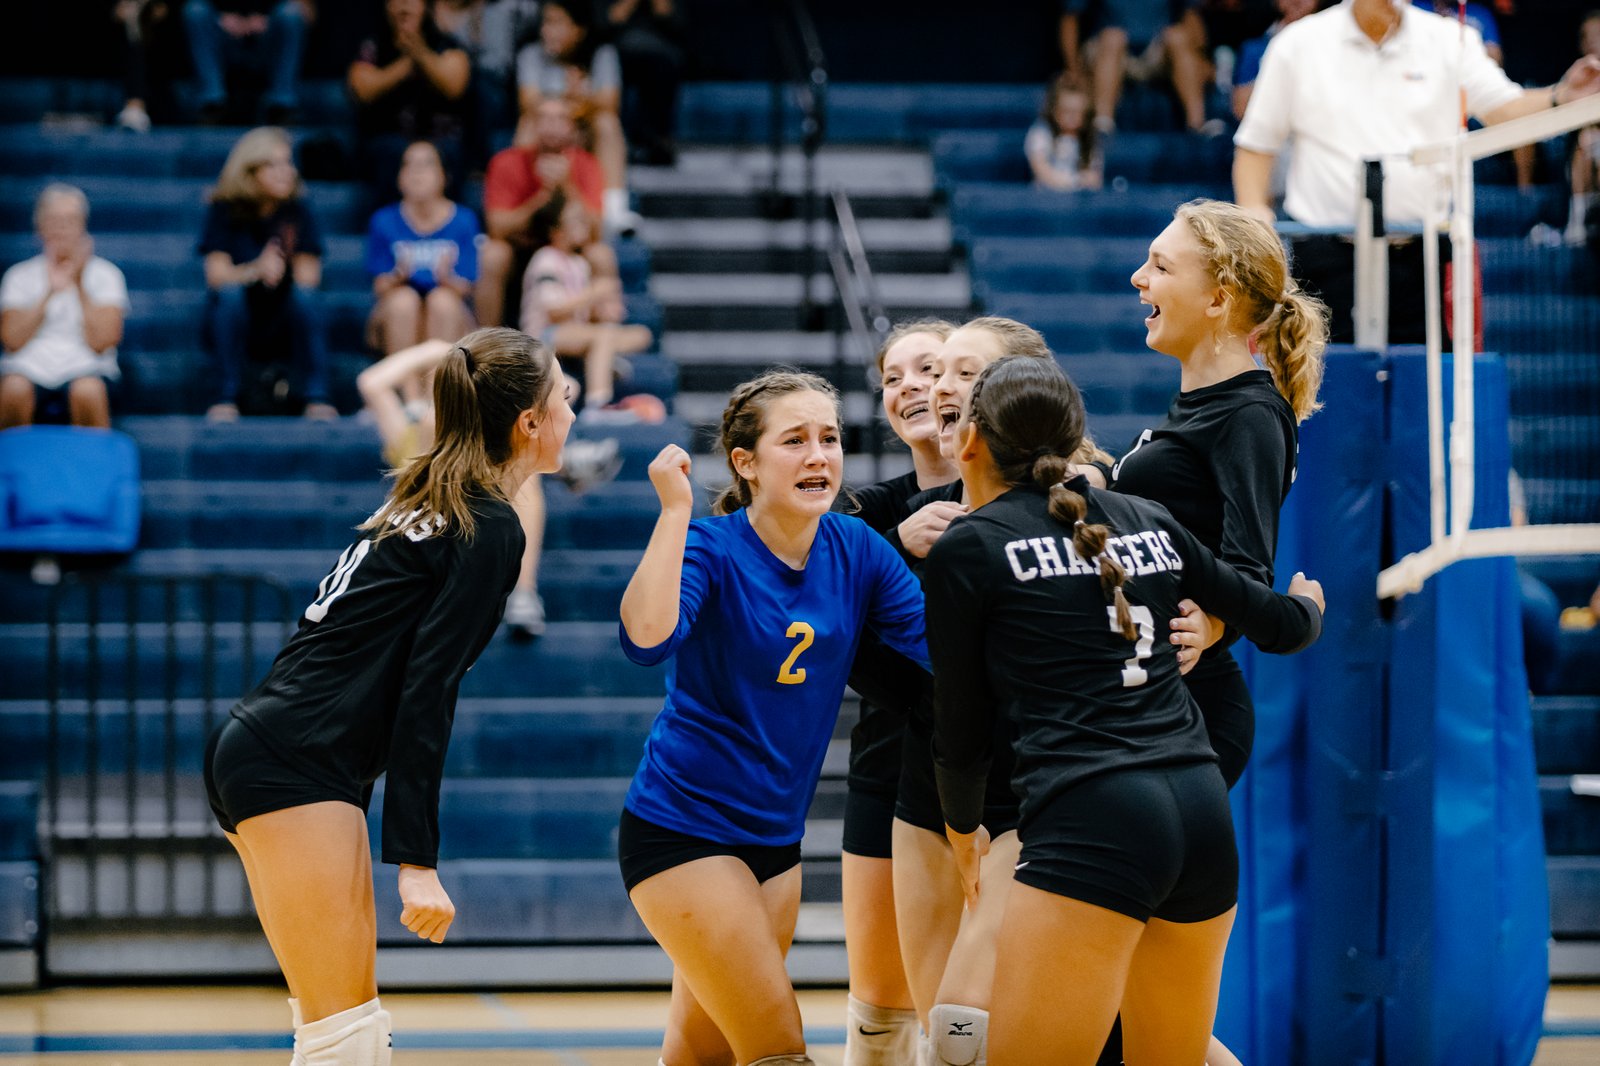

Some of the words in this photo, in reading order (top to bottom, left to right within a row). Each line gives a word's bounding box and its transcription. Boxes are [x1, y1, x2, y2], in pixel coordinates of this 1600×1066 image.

[1004, 530, 1184, 582] CHAGERS
[776, 621, 815, 685] 2
[1106, 605, 1155, 687] 7
